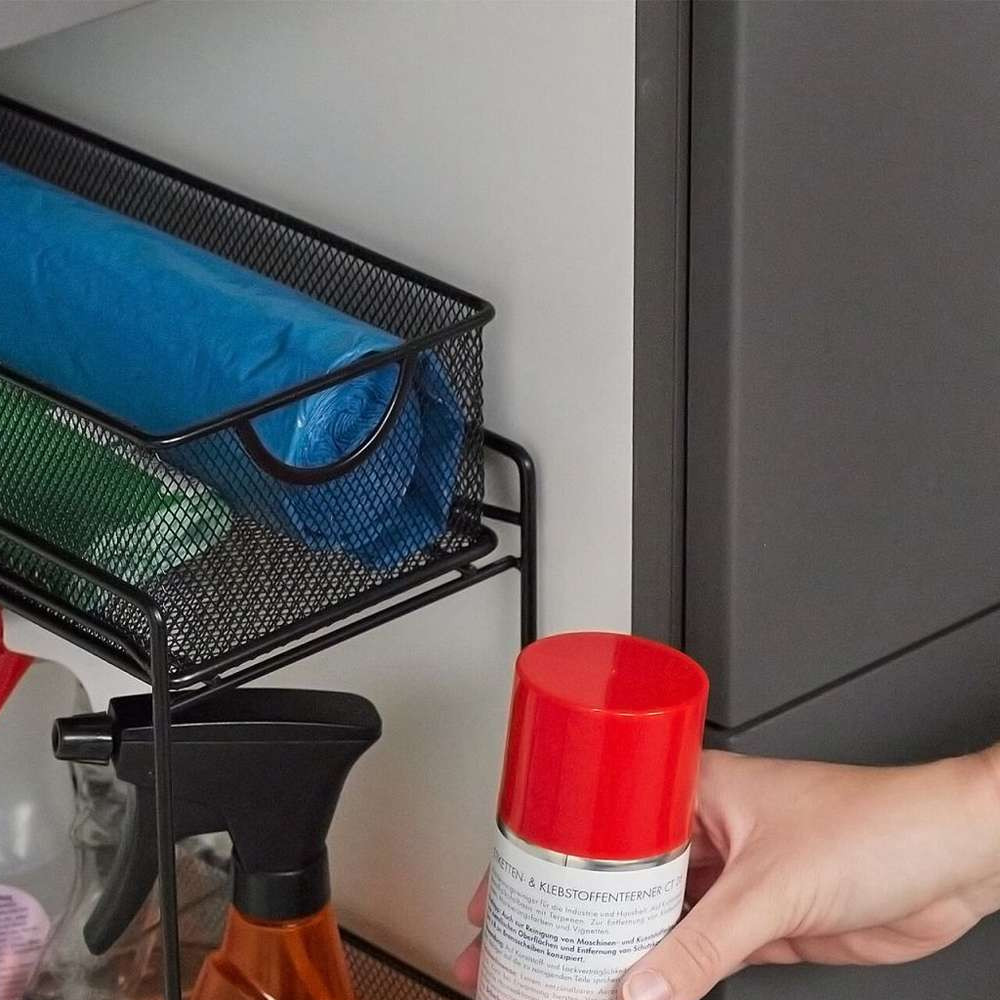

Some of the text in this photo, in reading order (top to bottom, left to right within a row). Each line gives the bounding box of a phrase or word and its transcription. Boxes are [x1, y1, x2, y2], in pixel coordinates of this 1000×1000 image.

[528, 876, 536, 889] &
[539, 881, 662, 903] KLEBSTOFFENTFERNER
[517, 928, 560, 950] Oberflächen
[559, 942, 575, 953] und
[576, 945, 617, 956] Entfernung
[524, 923, 559, 943] Reinigung
[559, 935, 575, 944] von
